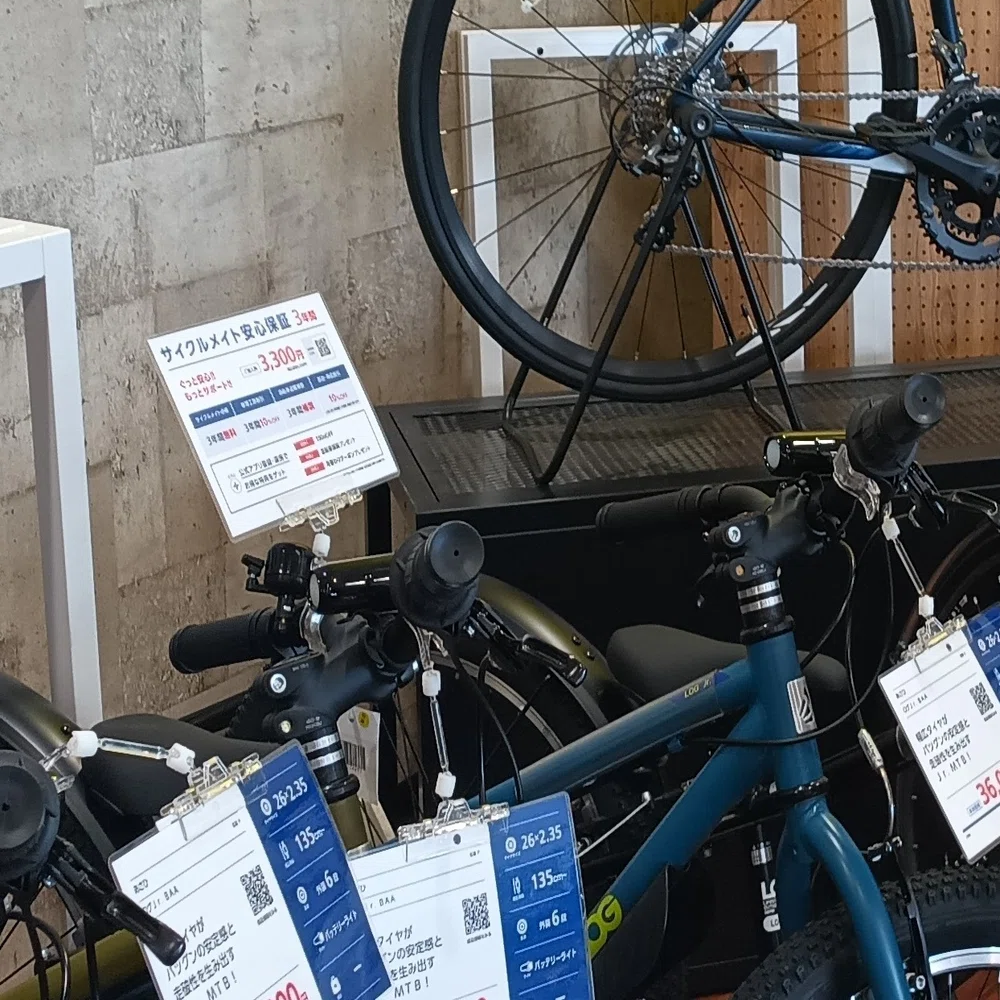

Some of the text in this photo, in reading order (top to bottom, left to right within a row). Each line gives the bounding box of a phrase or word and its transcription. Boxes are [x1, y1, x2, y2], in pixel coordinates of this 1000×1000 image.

[160, 308, 317, 363] サイクルメイト安心保証 3年間
[258, 344, 305, 372] 3,300円
[520, 825, 562, 850] 26×2.35
[183, 916, 204, 942] イヤが
[377, 925, 412, 947] タイヤが
[586, 894, 623, 960] OG
[387, 934, 443, 963] ンの安定感と
[533, 948, 576, 971] バッテリーライト
[390, 956, 436, 981] を生み出す
[206, 971, 236, 1000] MTB!
[394, 976, 429, 998] MTB!
